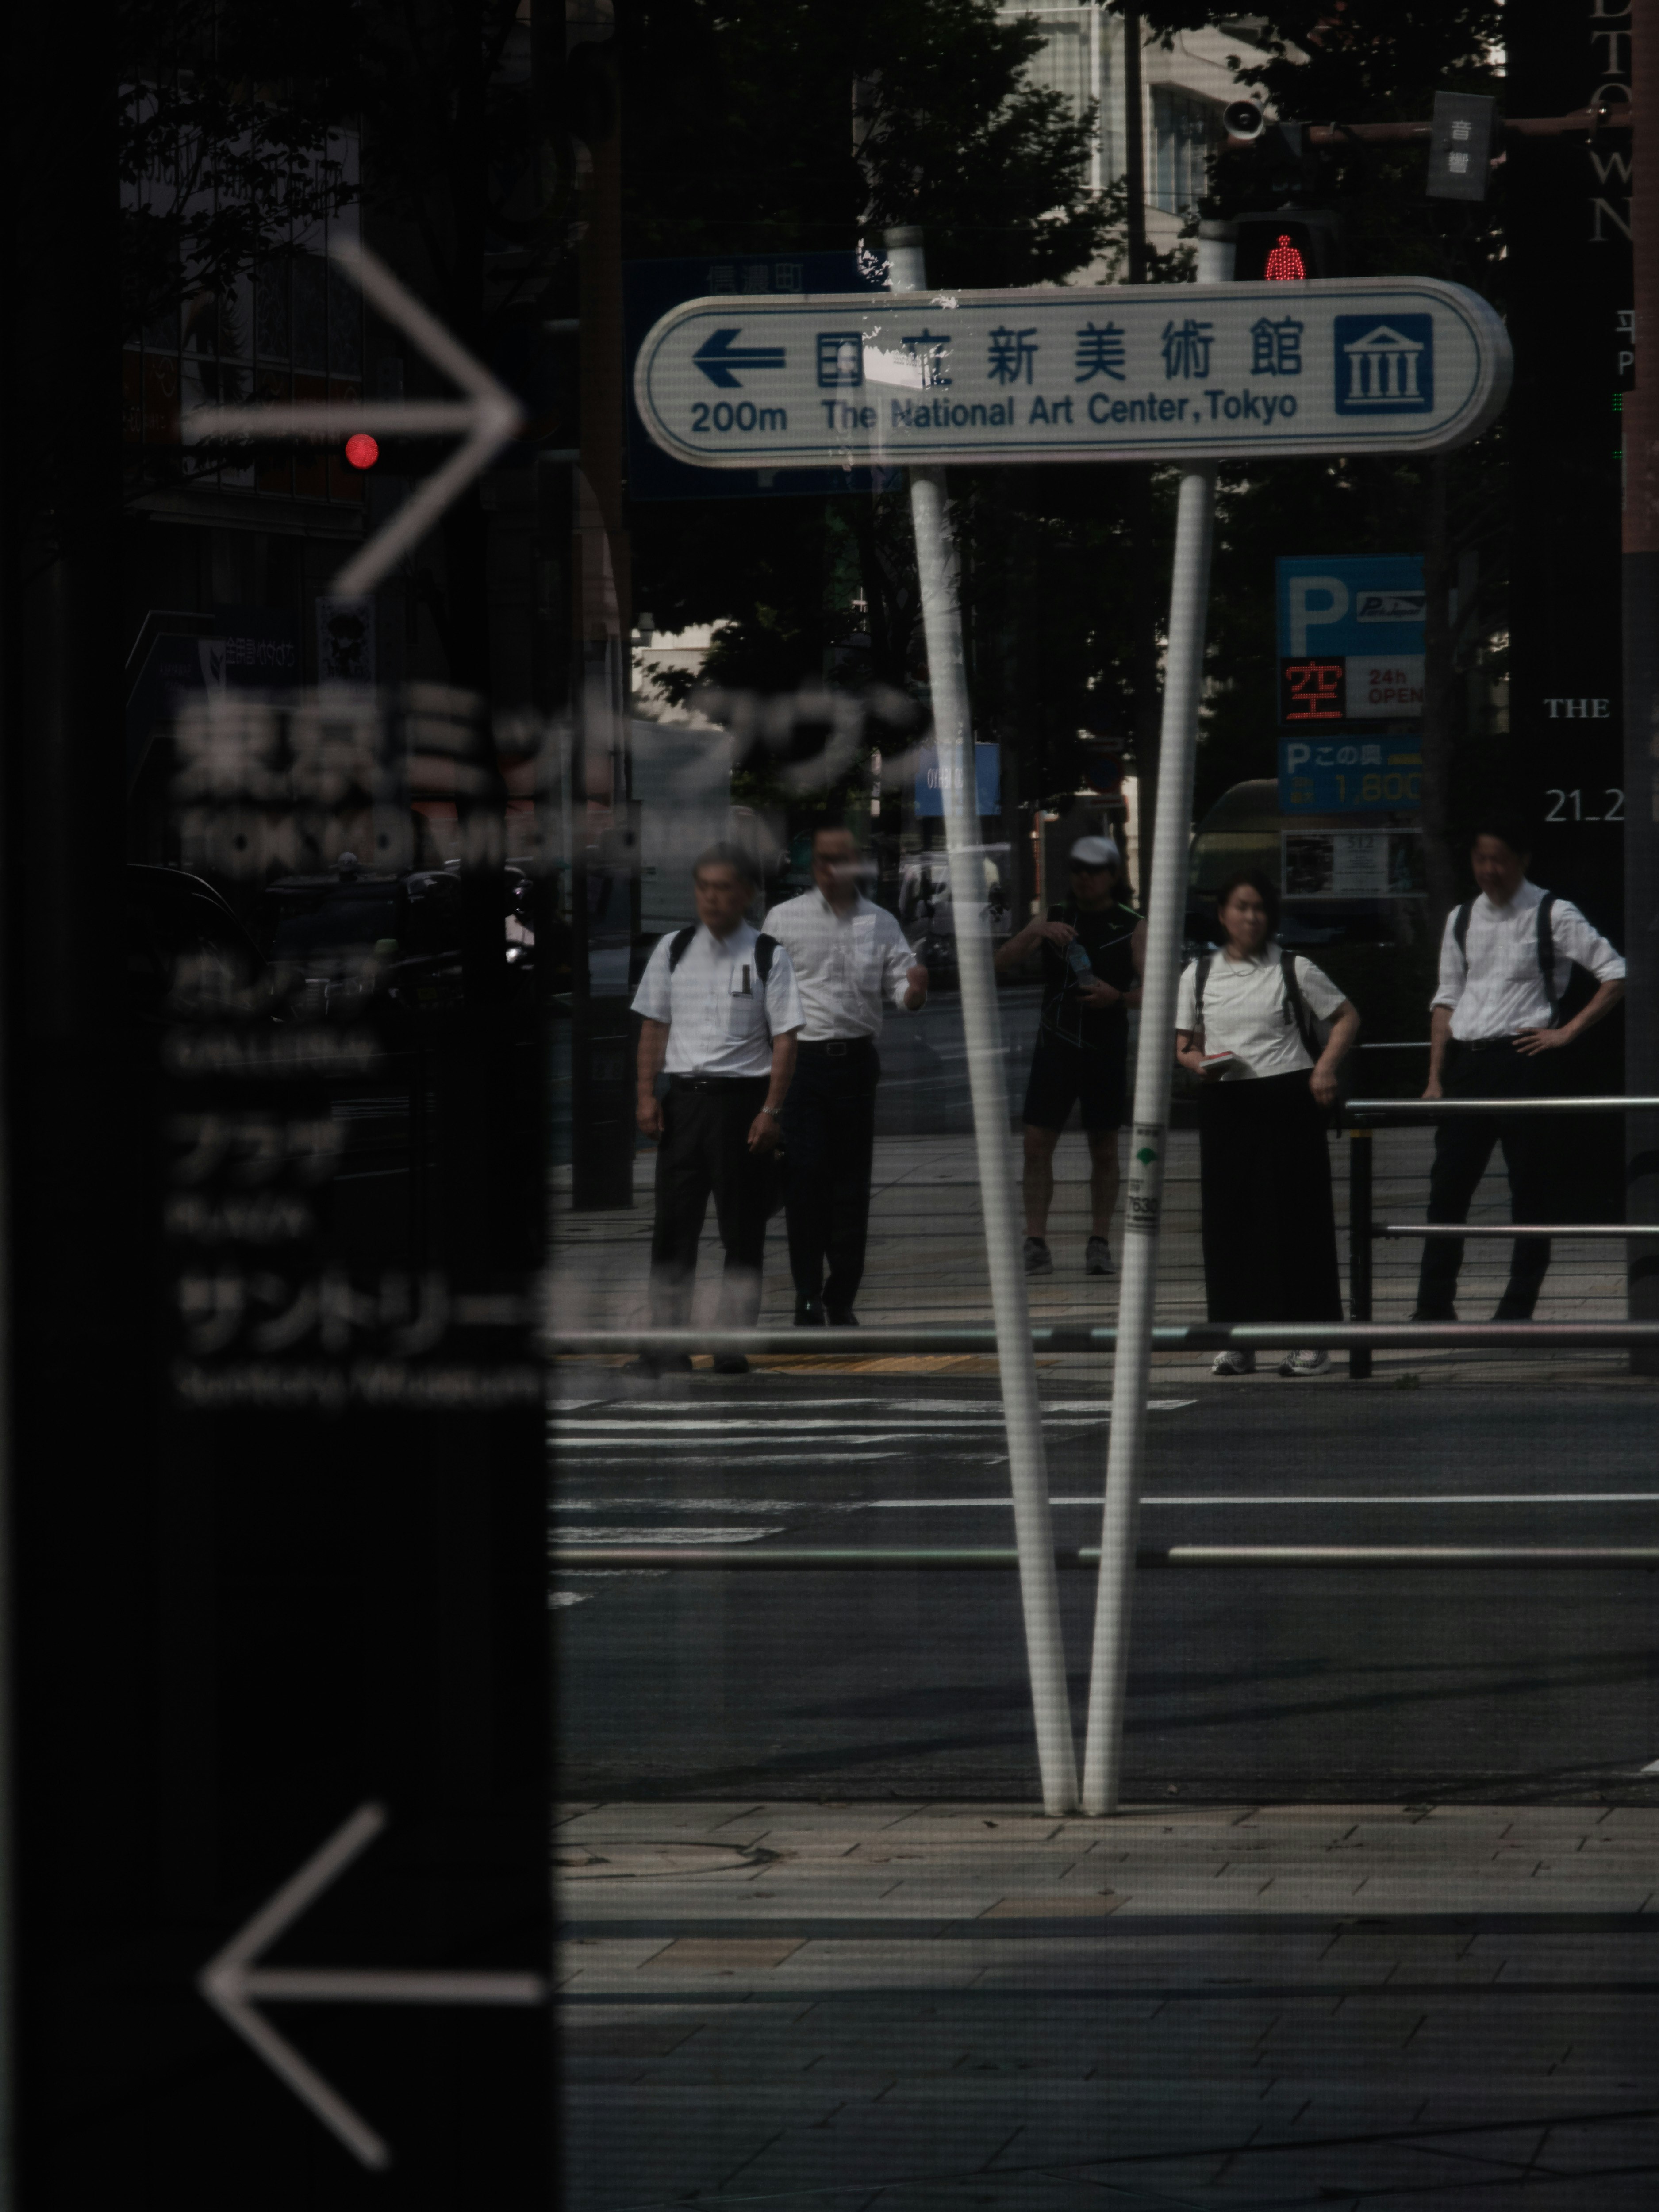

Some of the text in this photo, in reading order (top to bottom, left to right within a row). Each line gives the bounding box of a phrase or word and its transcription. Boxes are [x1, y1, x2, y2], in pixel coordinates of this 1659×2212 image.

[817, 315, 1303, 387] 国立新美術館
[691, 401, 787, 432] 200m
[821, 399, 878, 428] The
[891, 396, 1014, 428] National
[1029, 395, 1073, 424] Art
[1285, 661, 1343, 720] 空
[1368, 669, 1407, 685] 24h
[1368, 687, 1423, 704] OPEN
[1543, 697, 1611, 718] THE
